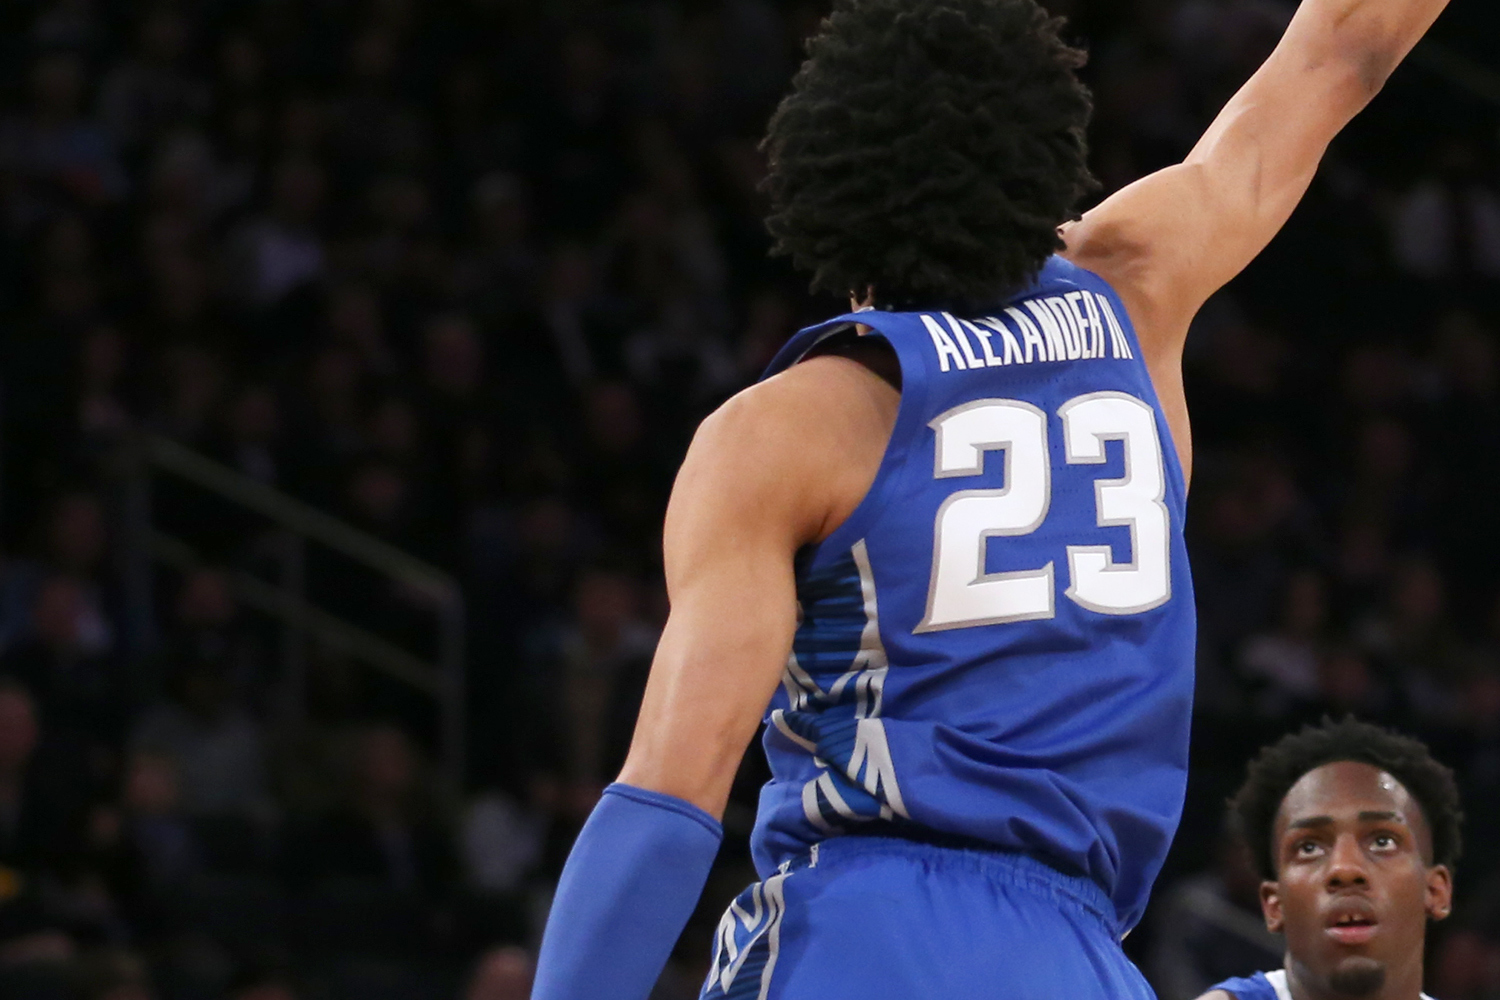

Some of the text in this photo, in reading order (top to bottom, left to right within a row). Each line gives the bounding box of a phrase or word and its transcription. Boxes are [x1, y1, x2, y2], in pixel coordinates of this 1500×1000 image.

[919, 290, 1133, 372] ALEXANDER III
[912, 390, 1171, 634] 23
